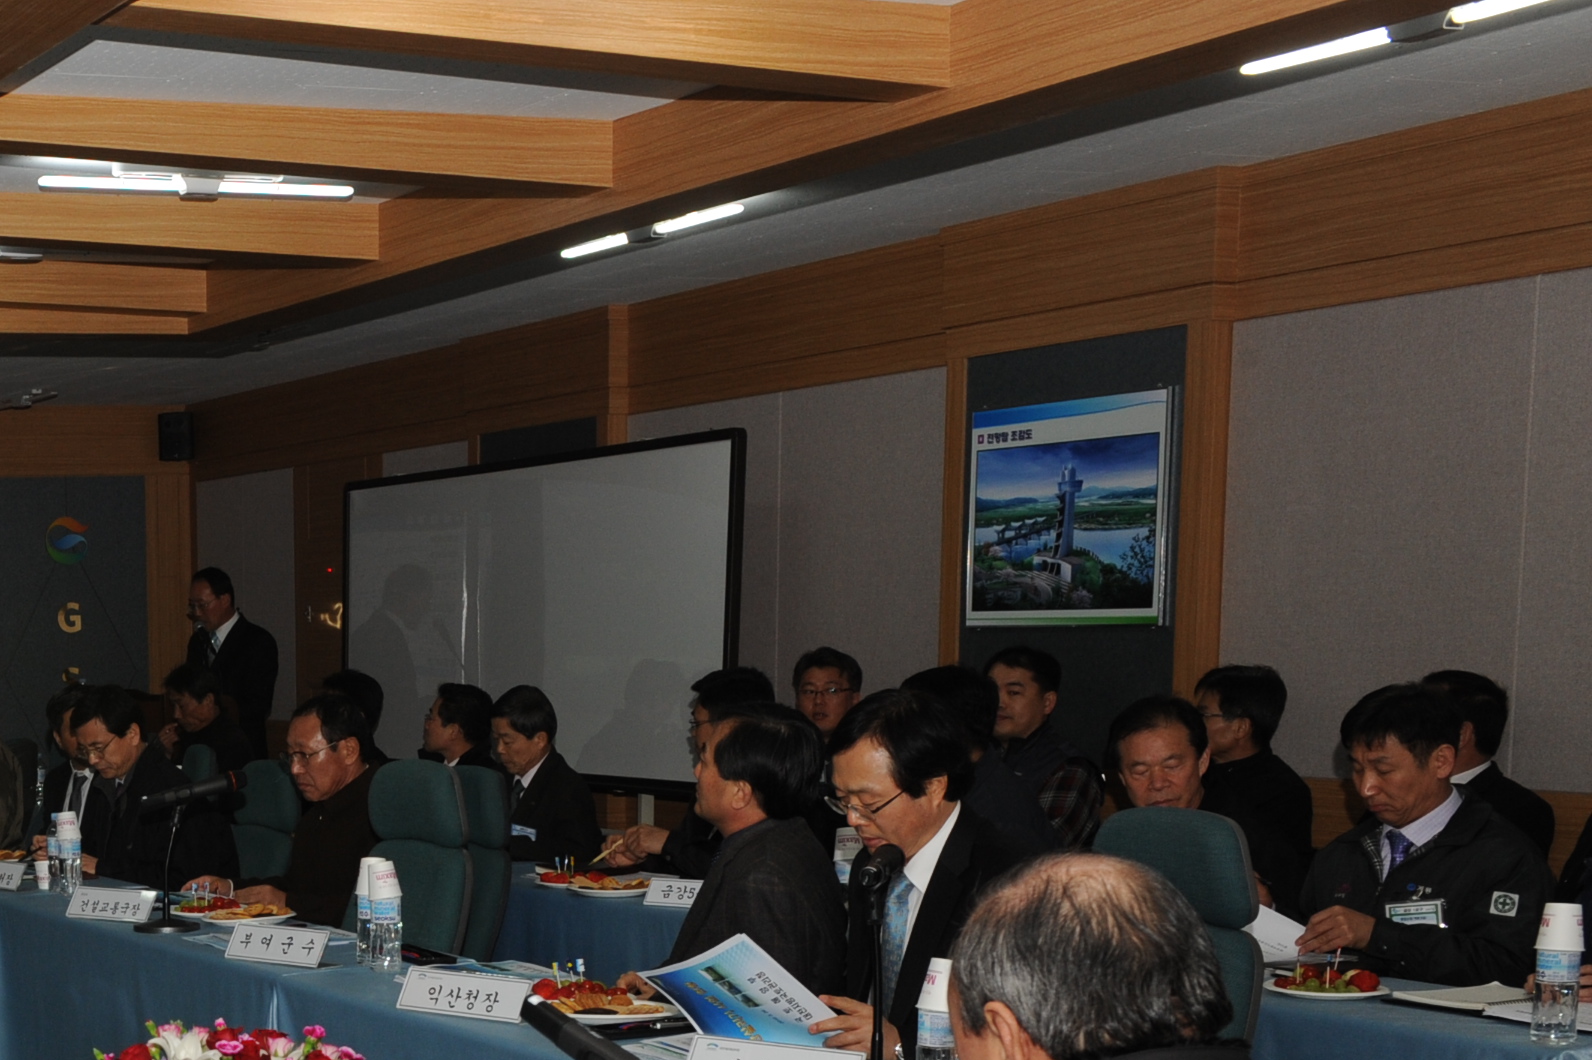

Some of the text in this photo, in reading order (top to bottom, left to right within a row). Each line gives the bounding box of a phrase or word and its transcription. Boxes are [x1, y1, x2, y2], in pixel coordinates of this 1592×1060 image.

[1010, 428, 1033, 442] 조감도
[80, 899, 141, 917] 건설교통국장
[239, 932, 315, 957] 부여군수
[428, 984, 500, 1013] 익산청장
